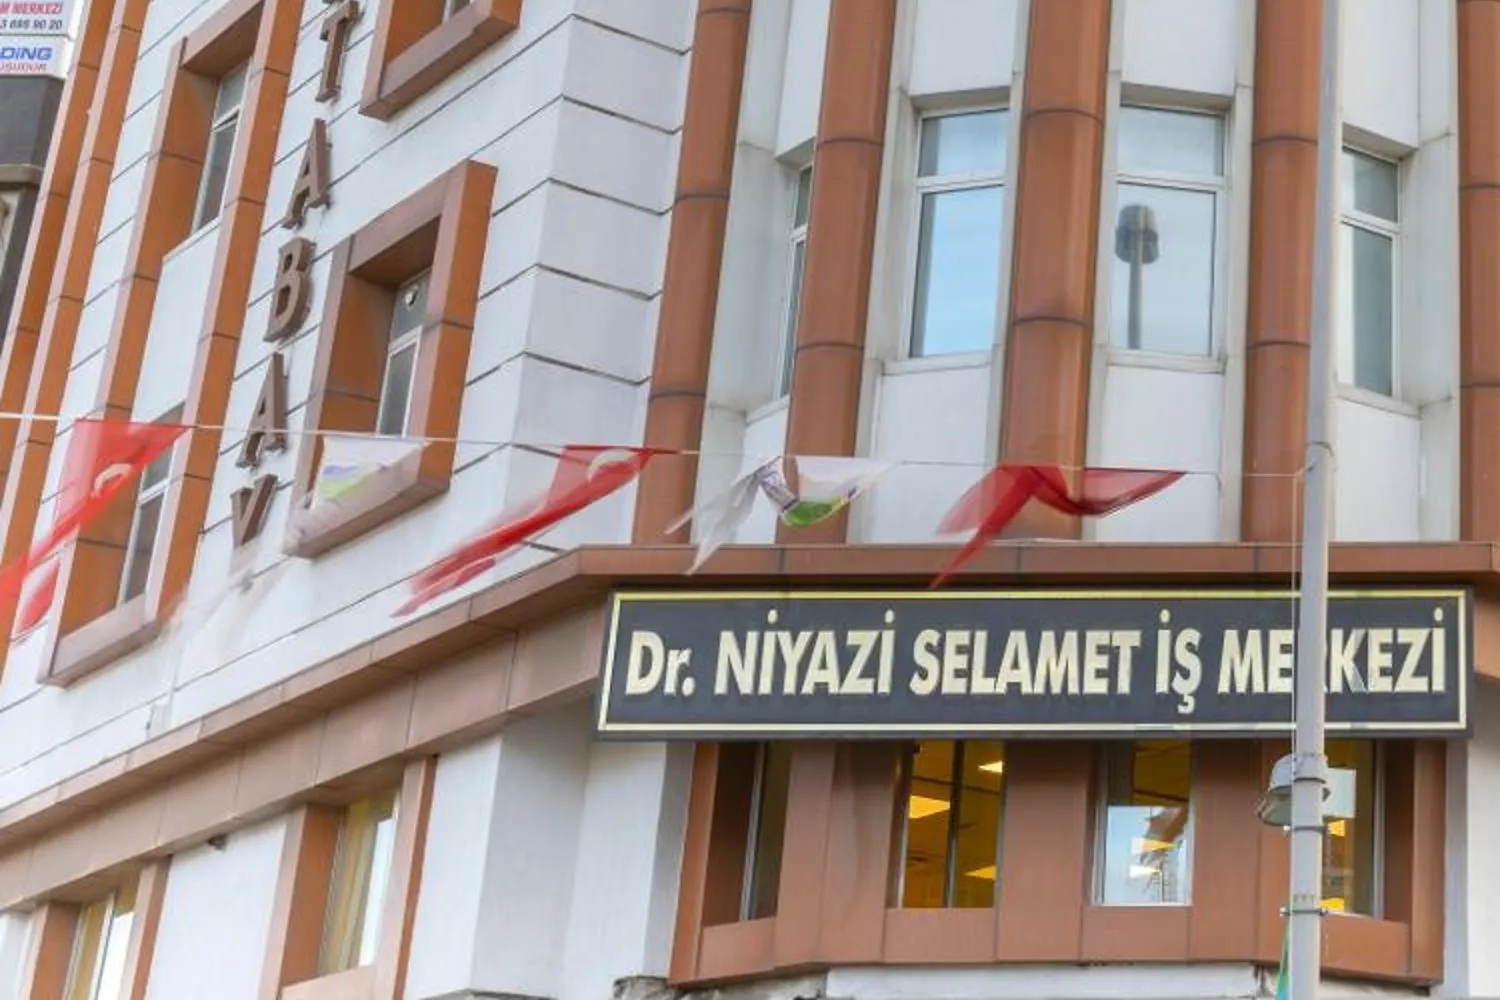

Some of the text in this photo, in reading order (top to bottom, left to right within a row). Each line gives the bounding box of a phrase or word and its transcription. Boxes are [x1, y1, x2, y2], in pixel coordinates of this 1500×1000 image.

[625, 606, 1446, 714] Dr. NİYAZİ SELAMET İŞ MEKEZİ
